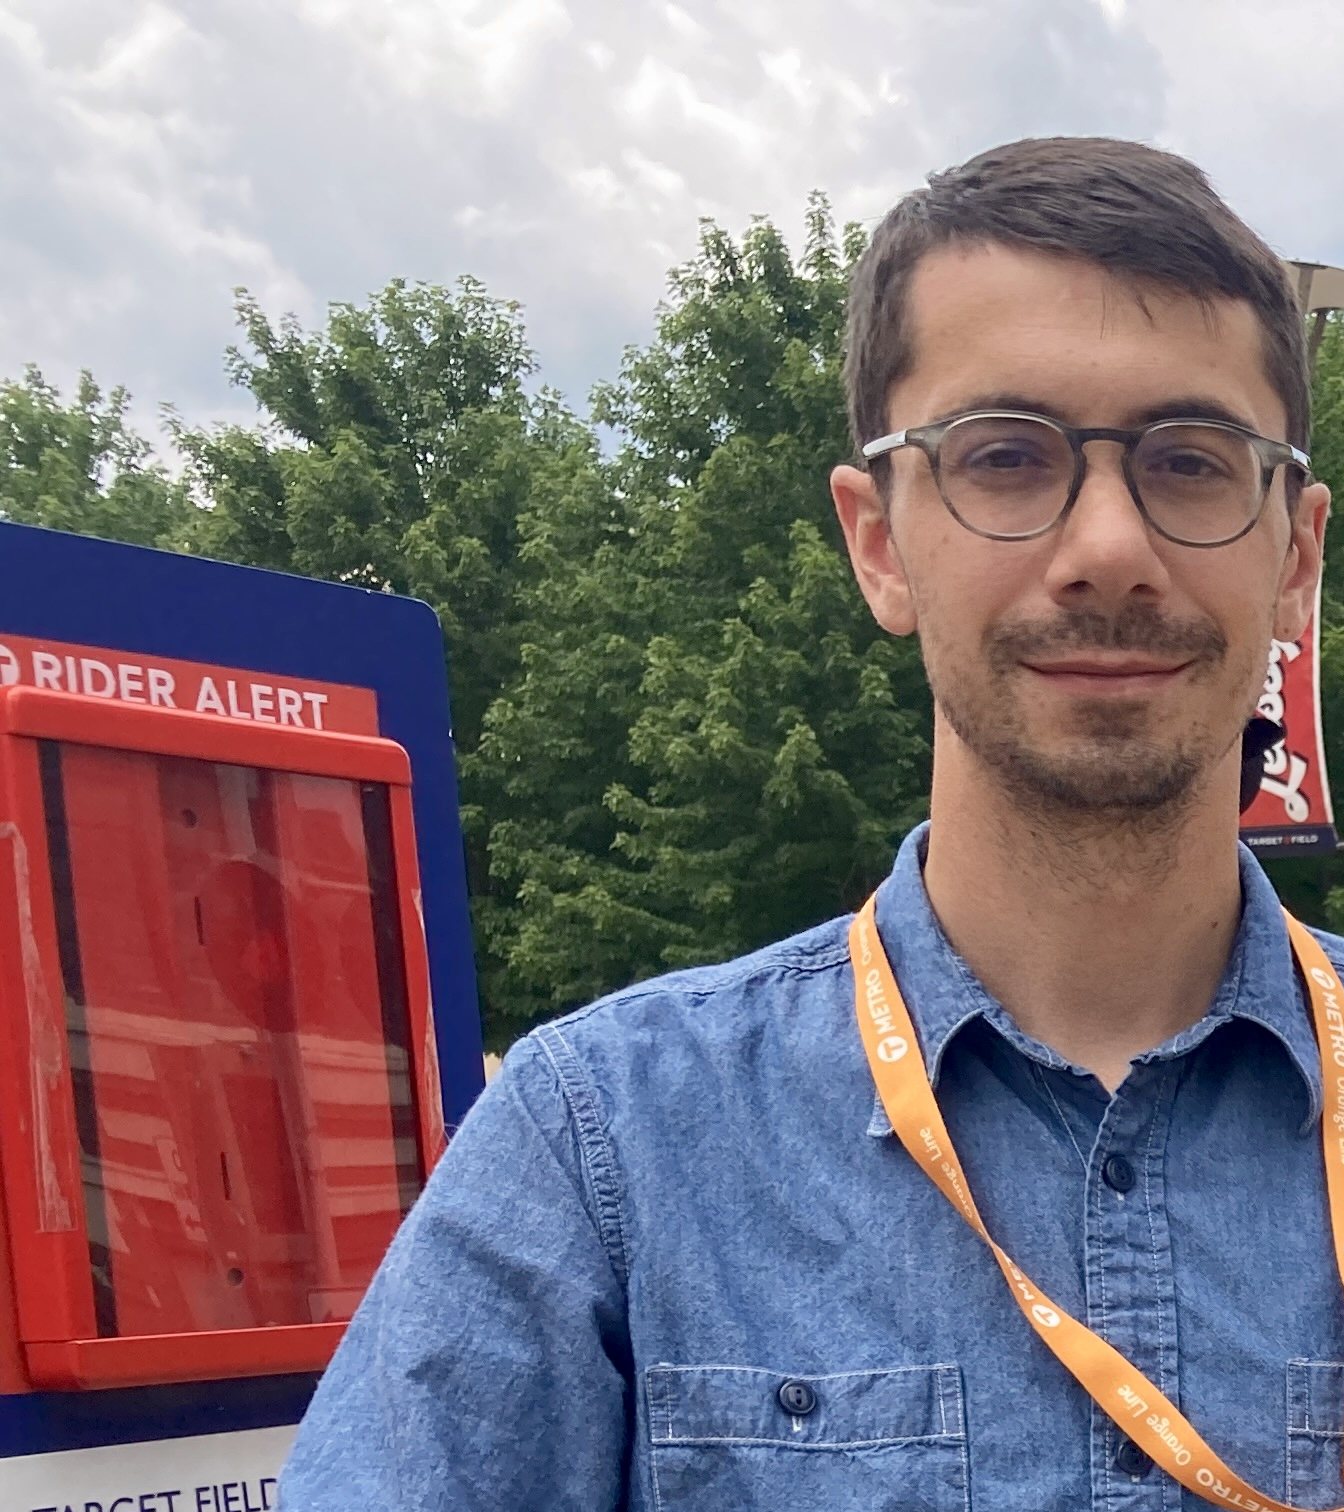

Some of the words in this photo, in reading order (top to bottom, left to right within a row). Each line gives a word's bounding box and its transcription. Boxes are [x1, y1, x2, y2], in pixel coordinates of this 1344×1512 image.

[33, 651, 177, 708] RIDER
[196, 677, 328, 730] ALERT
[1290, 834, 1319, 844] FIELD
[865, 969, 897, 1035] METRO
[919, 1127, 942, 1162] Line
[1116, 1384, 1149, 1418] Line
[1145, 1412, 1192, 1467] Orange
